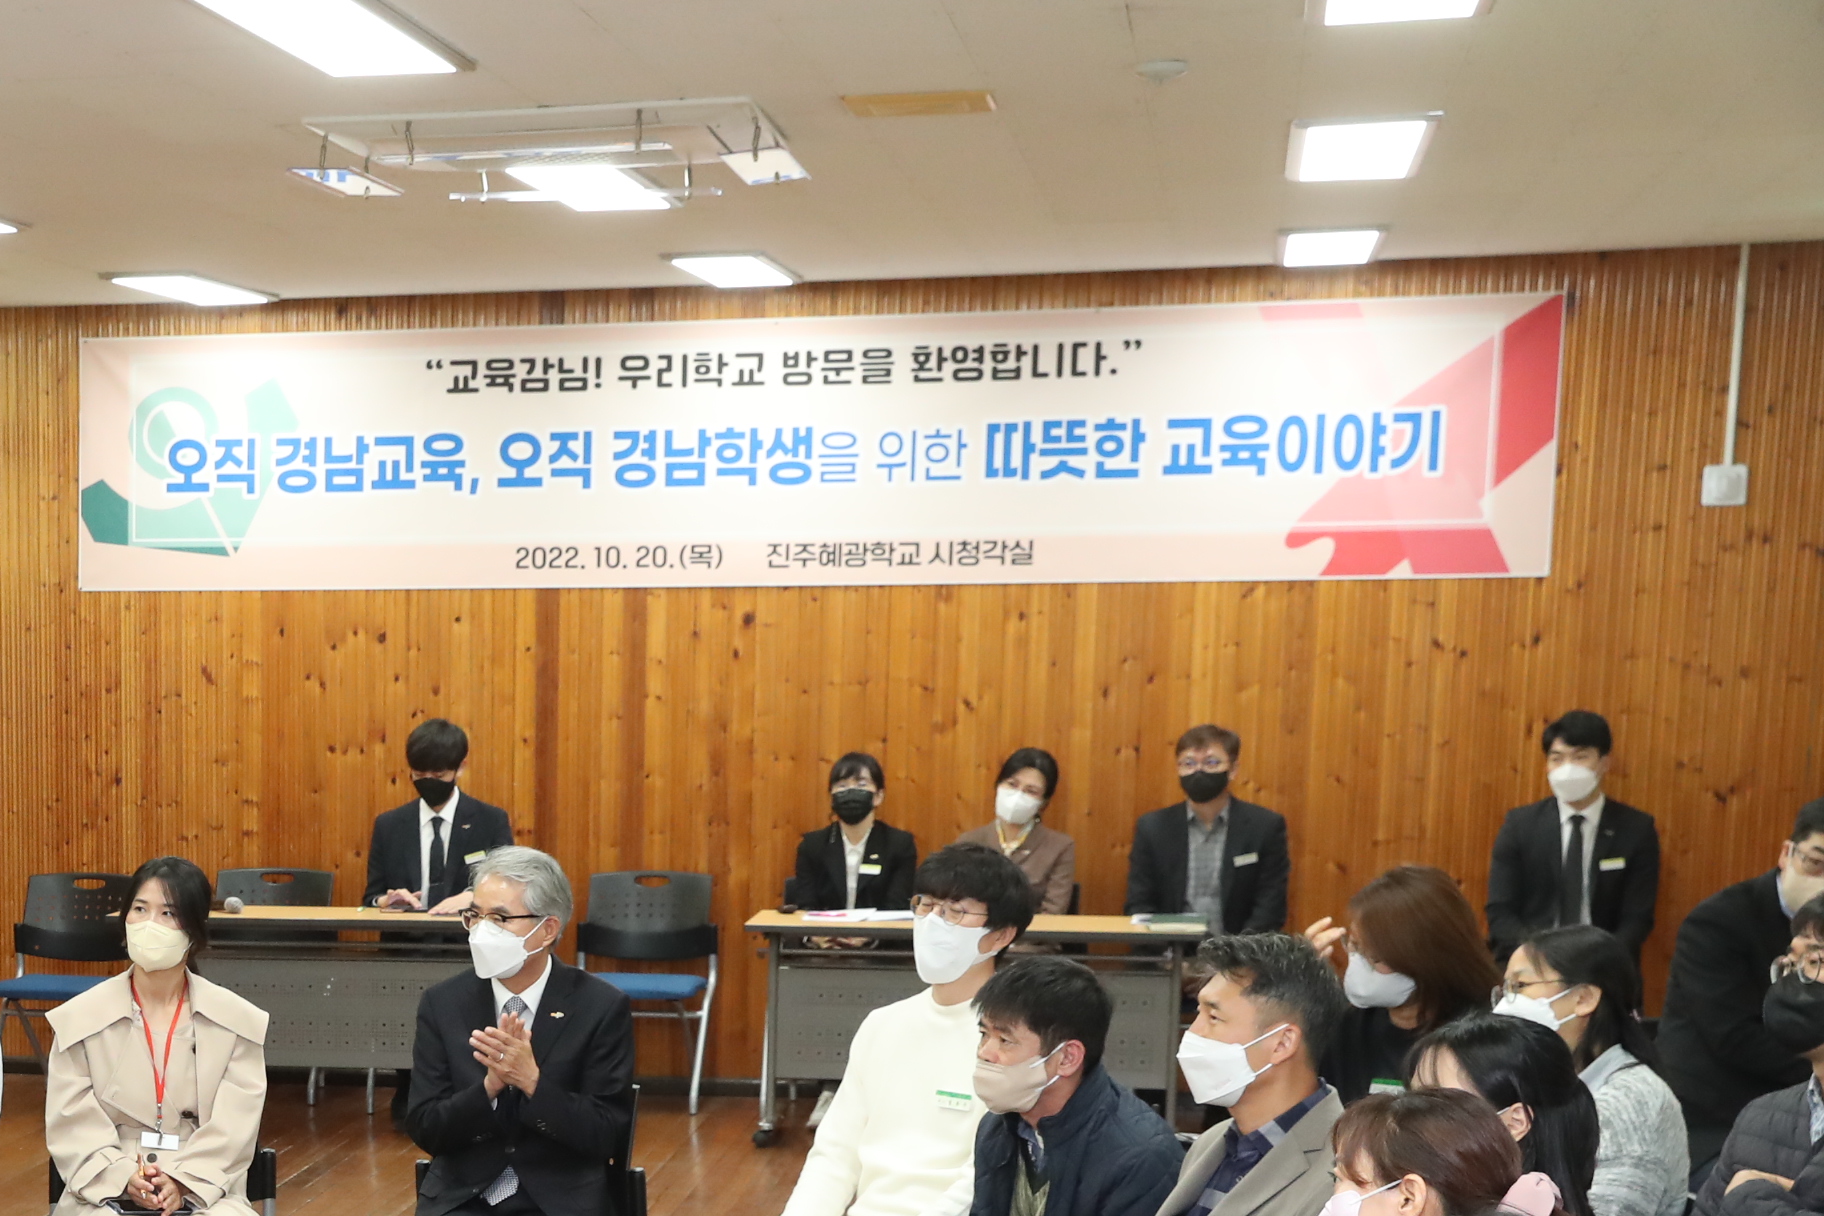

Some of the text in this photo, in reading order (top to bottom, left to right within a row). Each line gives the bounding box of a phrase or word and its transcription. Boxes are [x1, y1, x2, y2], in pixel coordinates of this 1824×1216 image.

[426, 340, 1142, 393] “교육감님! 우리학교 방문을 환영합니다.”
[166, 410, 1442, 495] 오직 경남교육, 오직 경남학생을 위한 따뜻한 교육이야기
[515, 539, 1035, 569] 2022. 10. 20.(목) 진주혜광학교 시청각실
